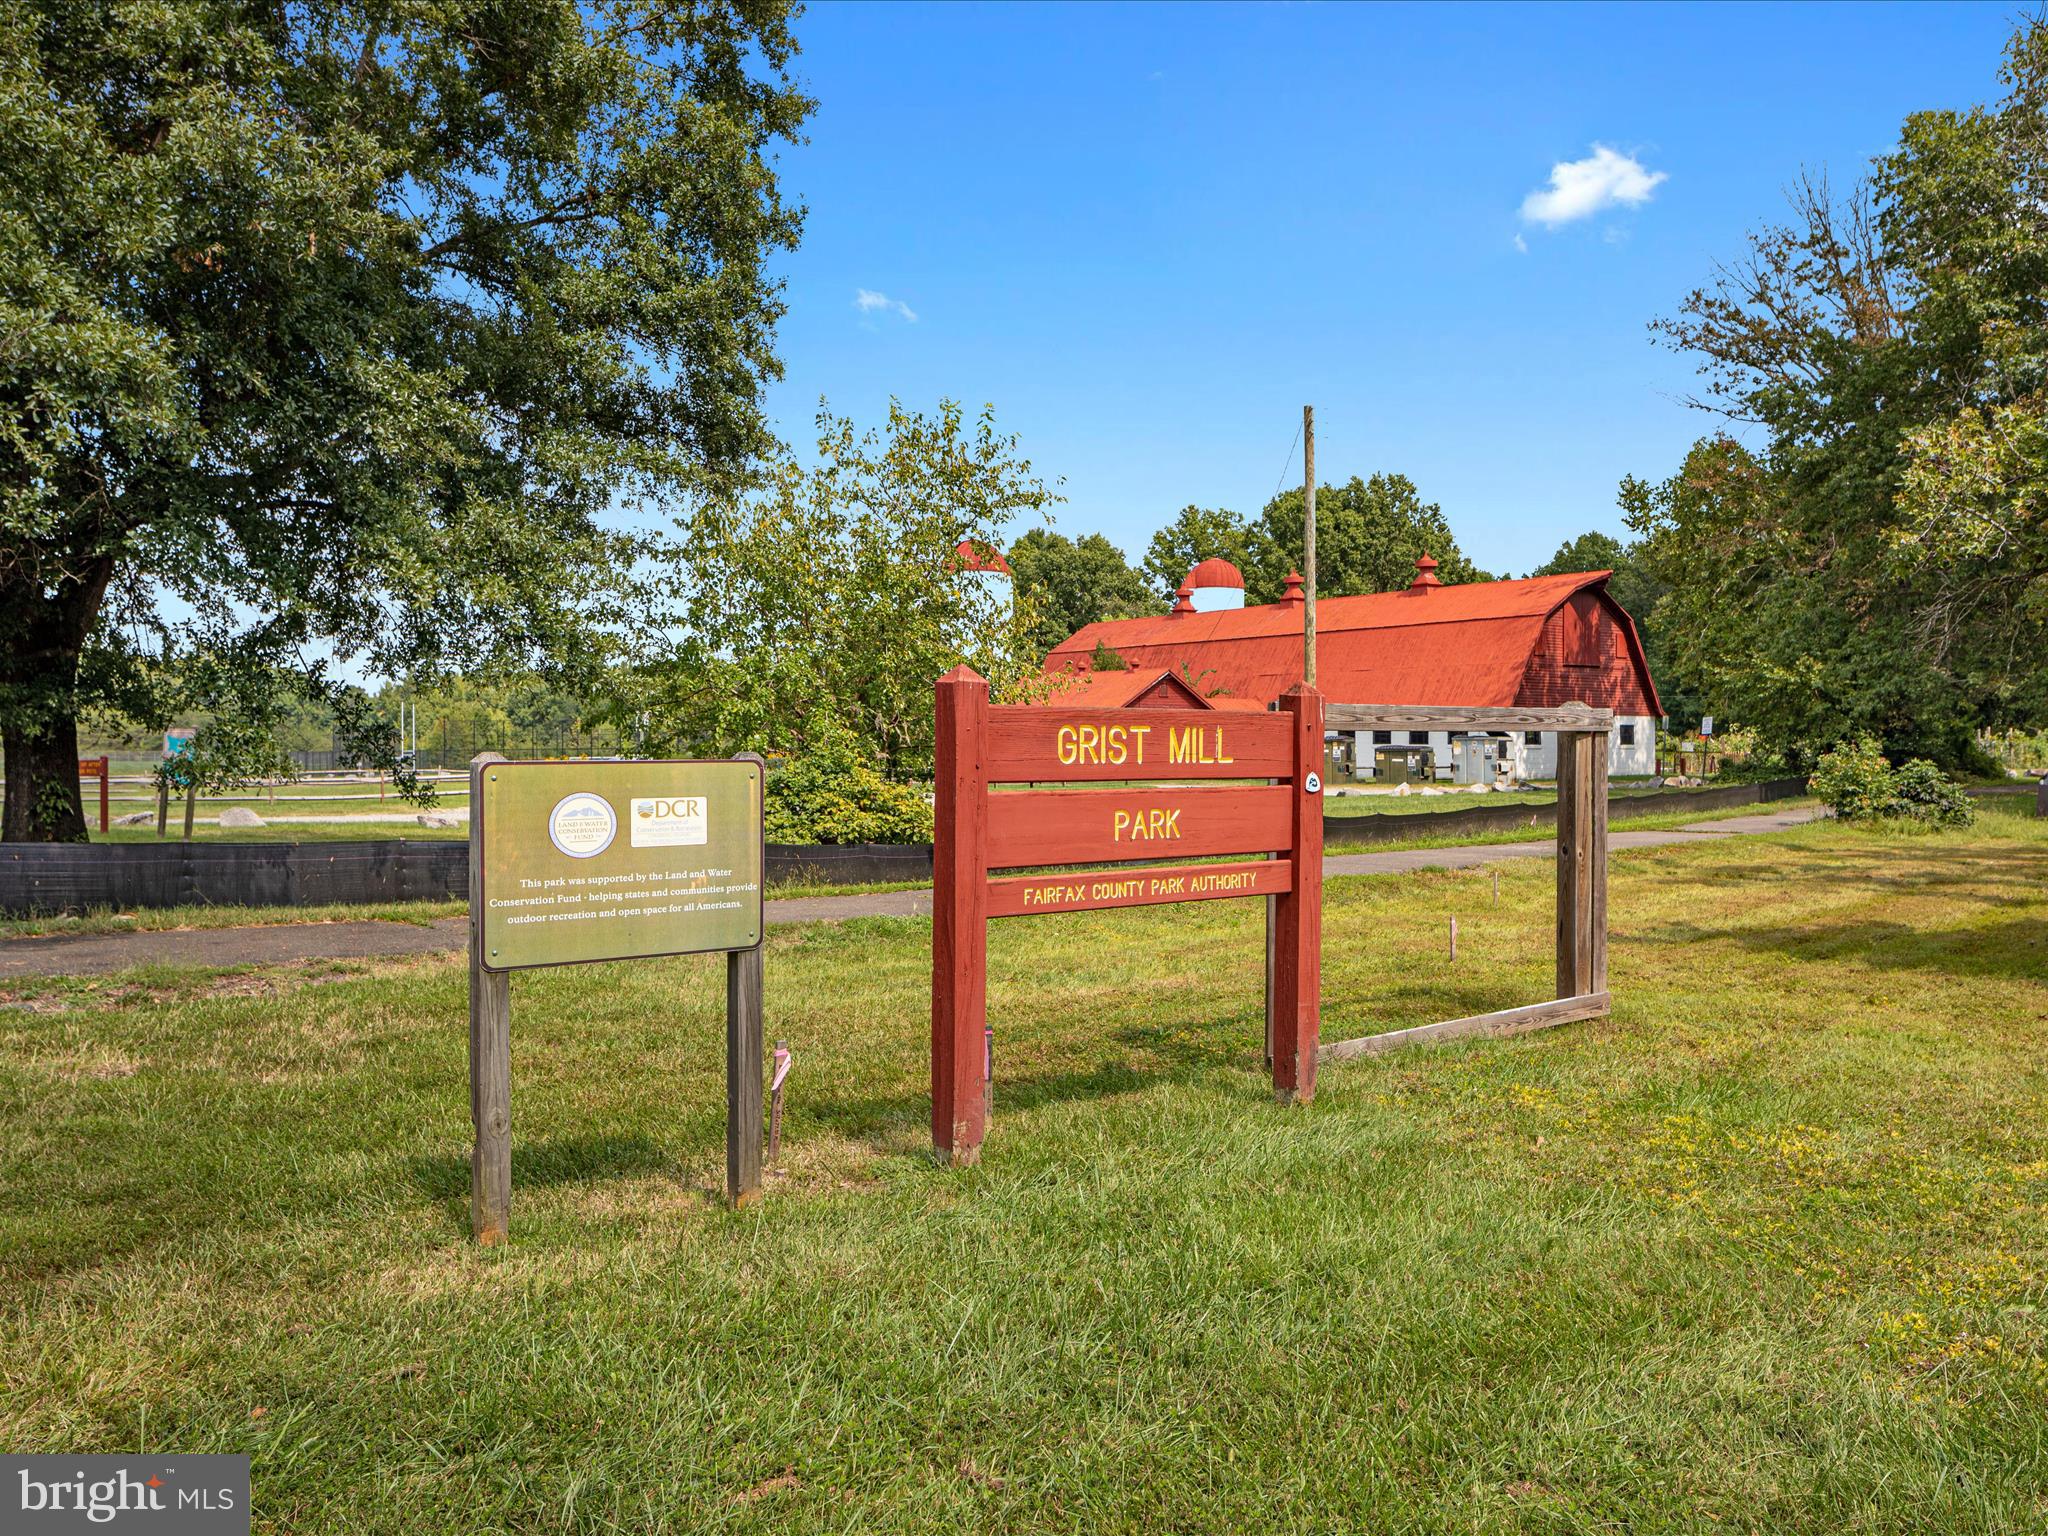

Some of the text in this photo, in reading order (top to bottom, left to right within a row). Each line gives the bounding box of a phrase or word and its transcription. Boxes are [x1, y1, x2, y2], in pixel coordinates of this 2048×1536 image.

[1058, 724, 1234, 765] GRIST MILL
[655, 800, 699, 818] DCR
[1114, 809, 1181, 842] PARK
[520, 879, 542, 888] This
[544, 877, 566, 888] park
[588, 873, 633, 885] supported
[636, 871, 647, 883] by
[649, 872, 663, 880] the
[665, 870, 687, 879] Land
[690, 870, 706, 878] and
[708, 868, 732, 877] Water
[1024, 872, 1257, 906] FAIRFAX COUNTY PARK AUTHORITY
[489, 896, 554, 908] Conservation
[557, 894, 581, 903] Fund
[589, 891, 623, 902] helping
[625, 890, 649, 898] states
[652, 888, 668, 897] and
[670, 885, 724, 895] communities
[726, 882, 757, 894] provide
[507, 901, 743, 924] outdoor recreation and open space for all Americans.
